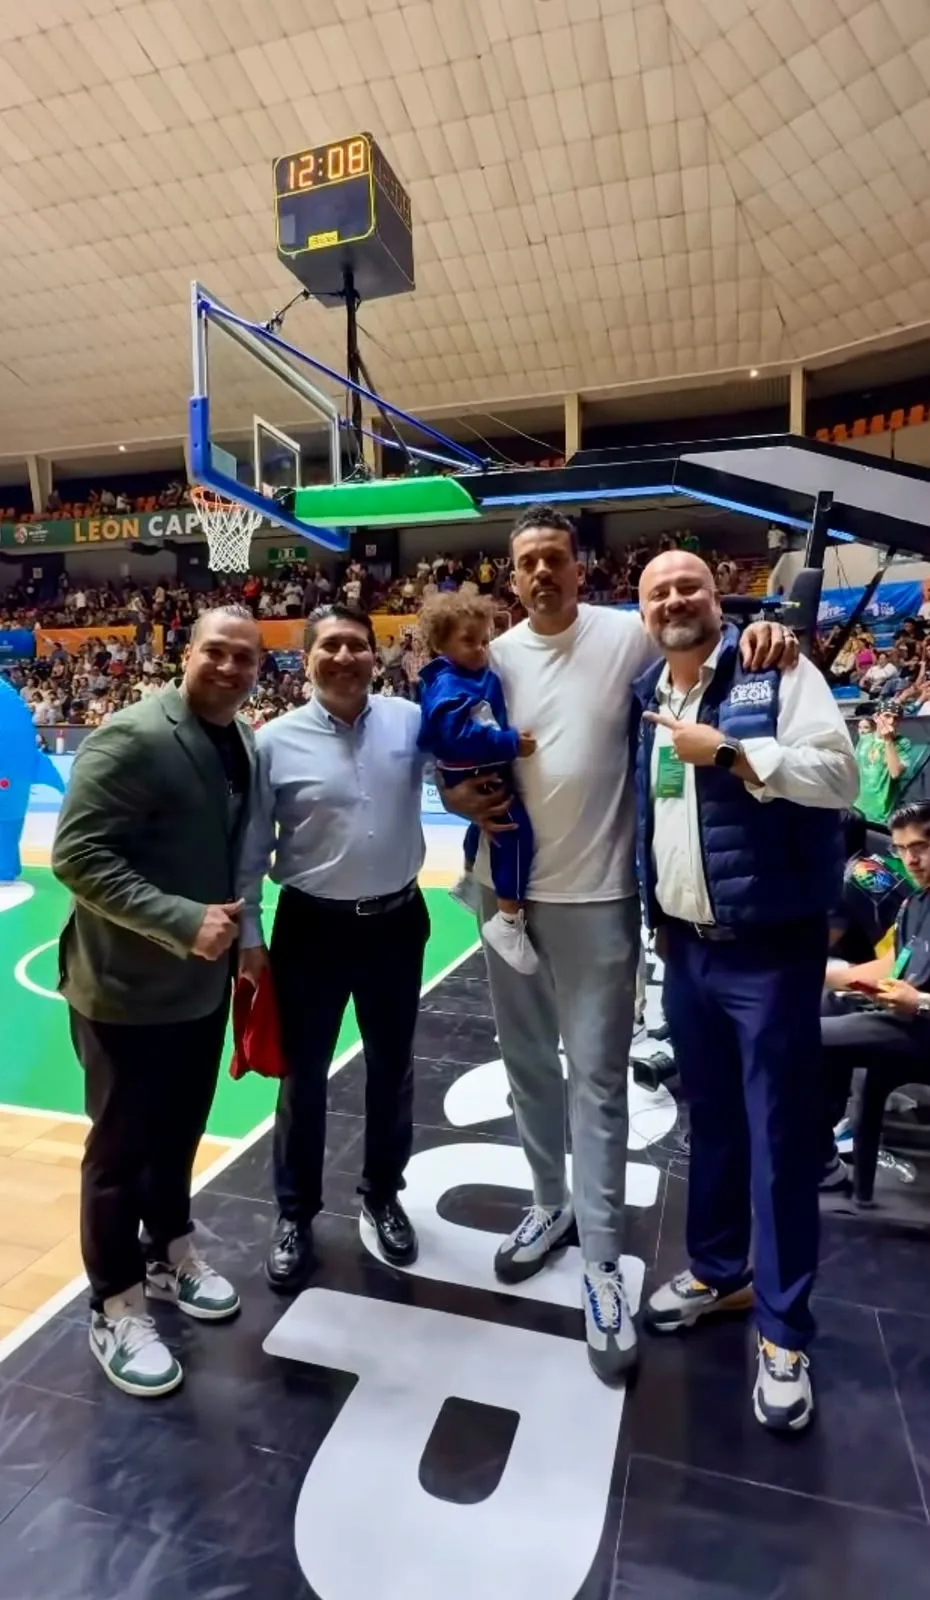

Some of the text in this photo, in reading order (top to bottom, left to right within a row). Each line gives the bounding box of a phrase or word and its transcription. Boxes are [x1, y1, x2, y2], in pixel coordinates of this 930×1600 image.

[289, 141, 364, 189] 12:08
[74, 515, 140, 542] LEÓN
[148, 513, 202, 537] CAP
